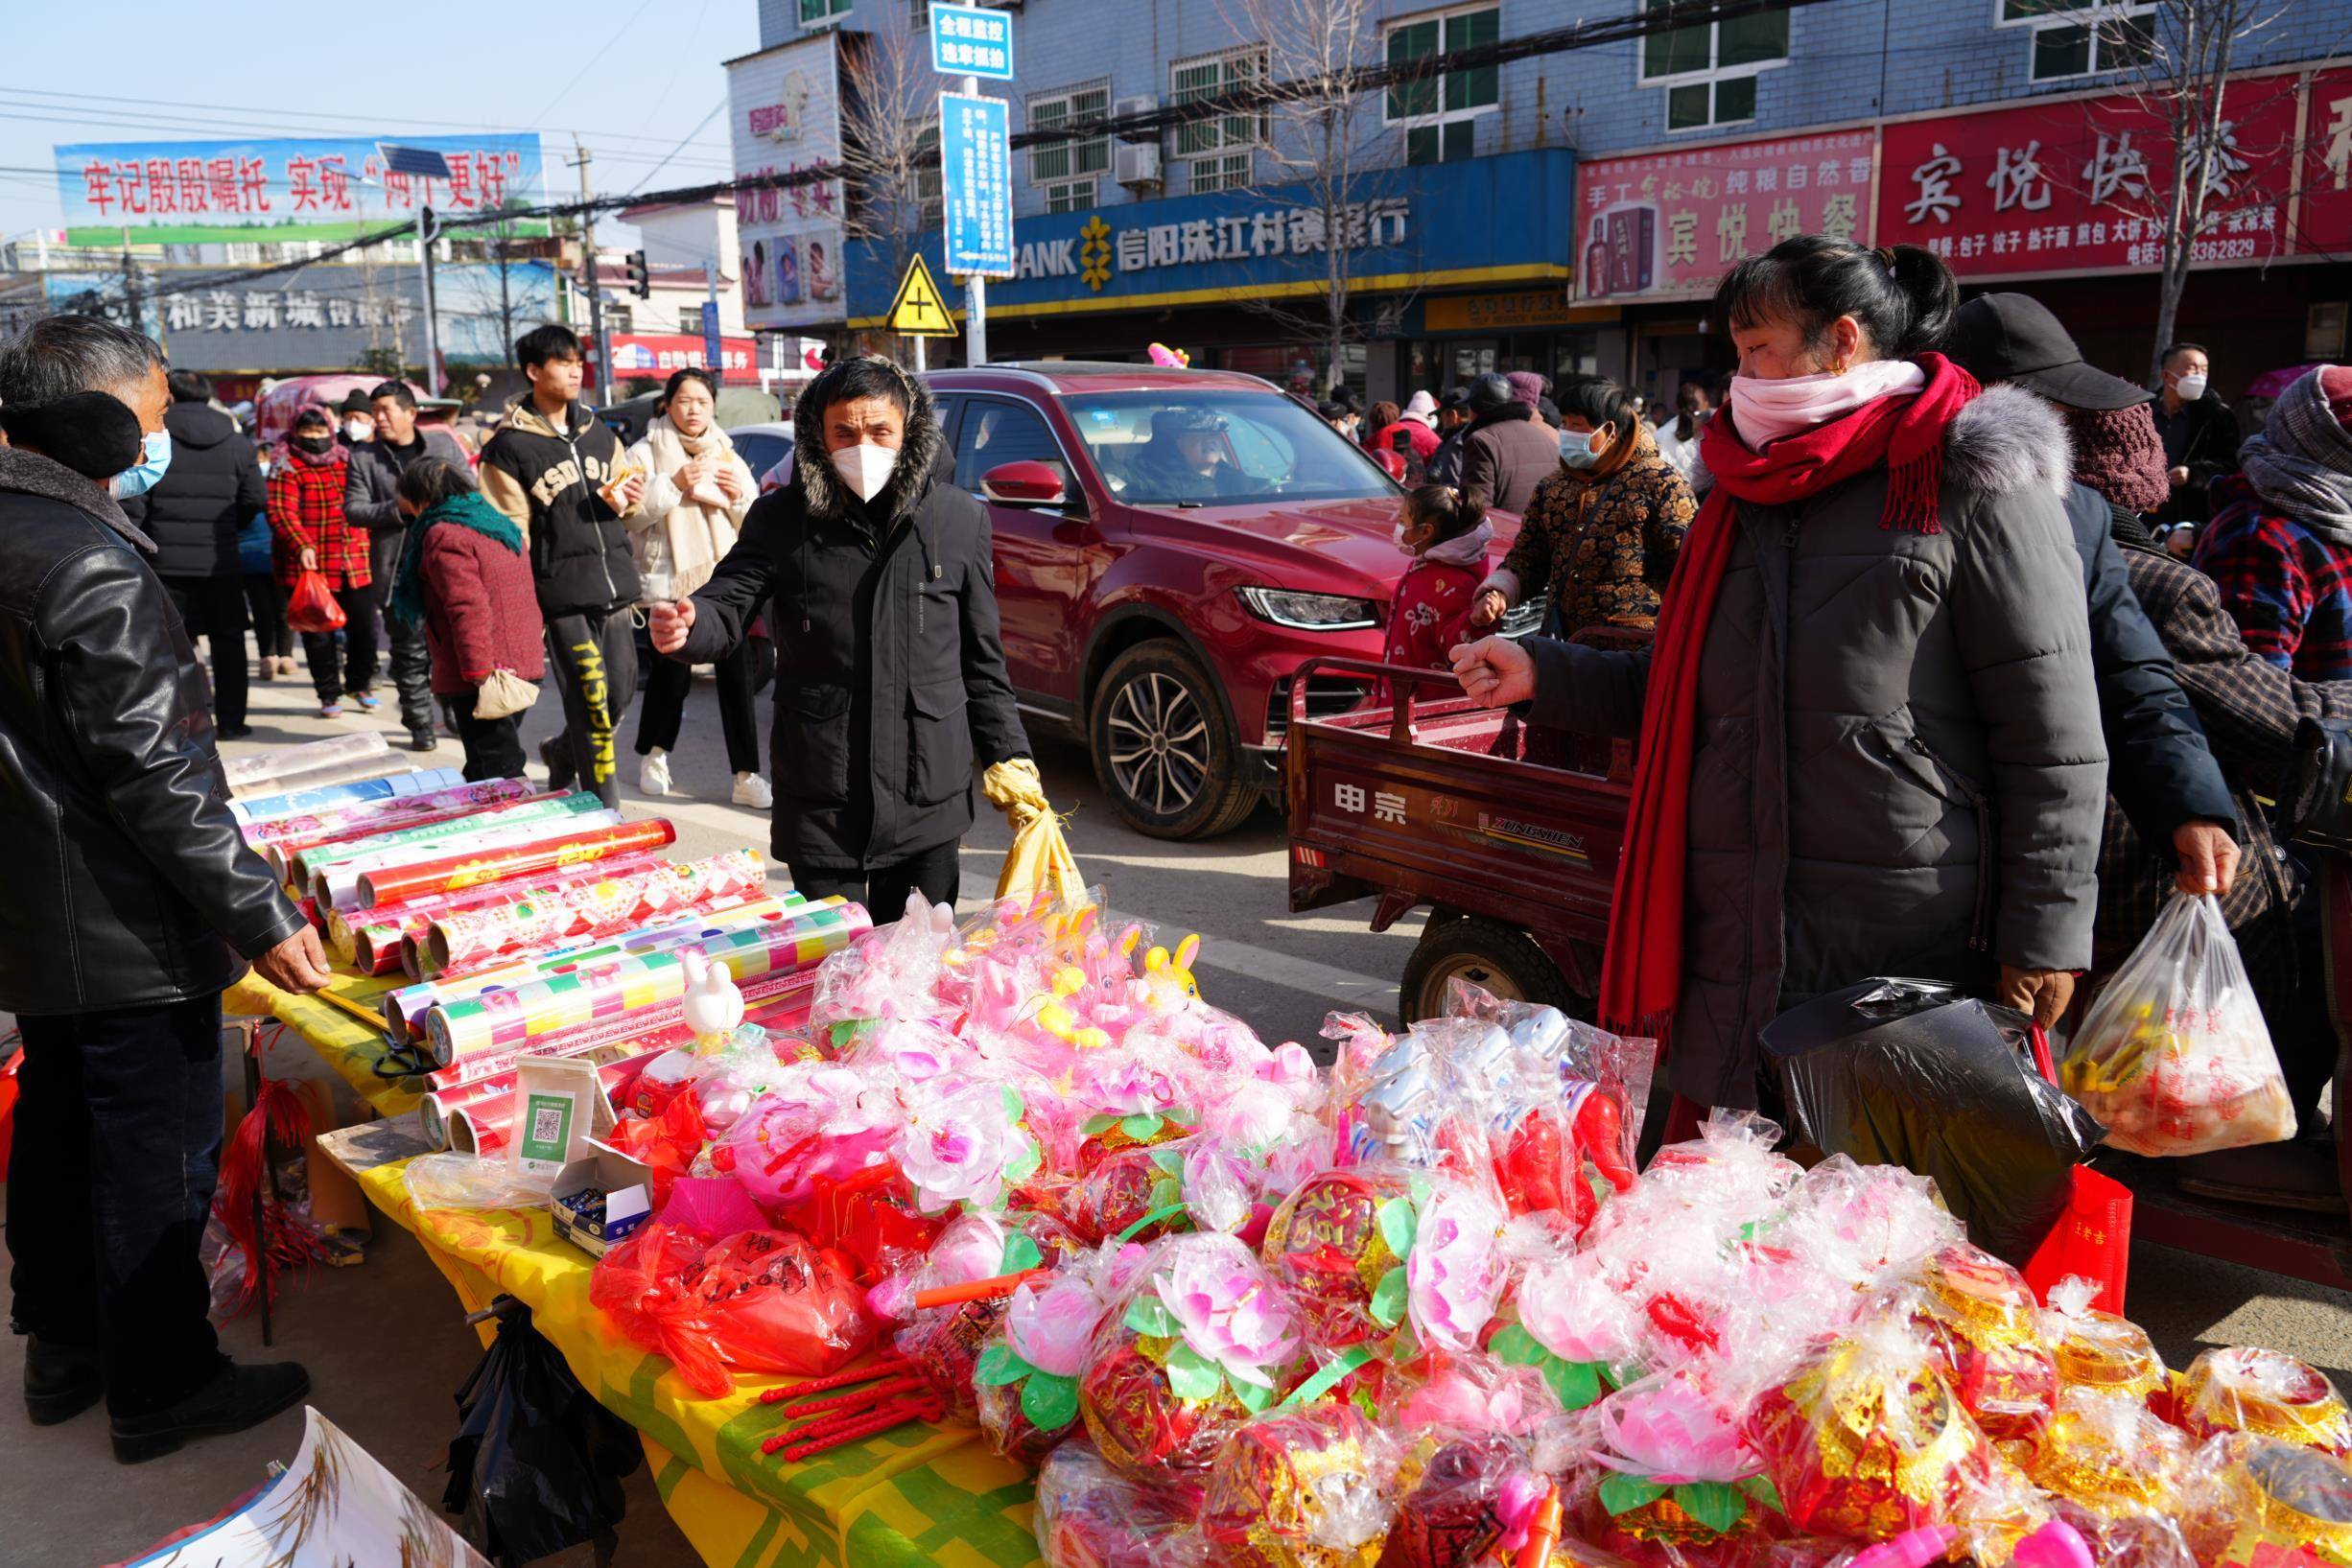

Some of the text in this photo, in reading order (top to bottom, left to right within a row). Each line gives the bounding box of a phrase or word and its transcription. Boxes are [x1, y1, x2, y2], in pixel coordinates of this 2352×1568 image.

[83, 155, 270, 216] 牢记殷殷嘱托
[288, 154, 351, 211] 实现
[1588, 182, 1633, 208] 手工
[1727, 155, 1873, 196] 纯粮自然香
[1904, 120, 2250, 224] 宾悦快餐
[1116, 197, 1411, 272] 信阳珠江村镇银行
[2028, 225, 2071, 251] 热干面
[658, 349, 747, 370] 自助银服务
[1334, 783, 1407, 826] 申宗
[2075, 1221, 2107, 1245] 王老吉
